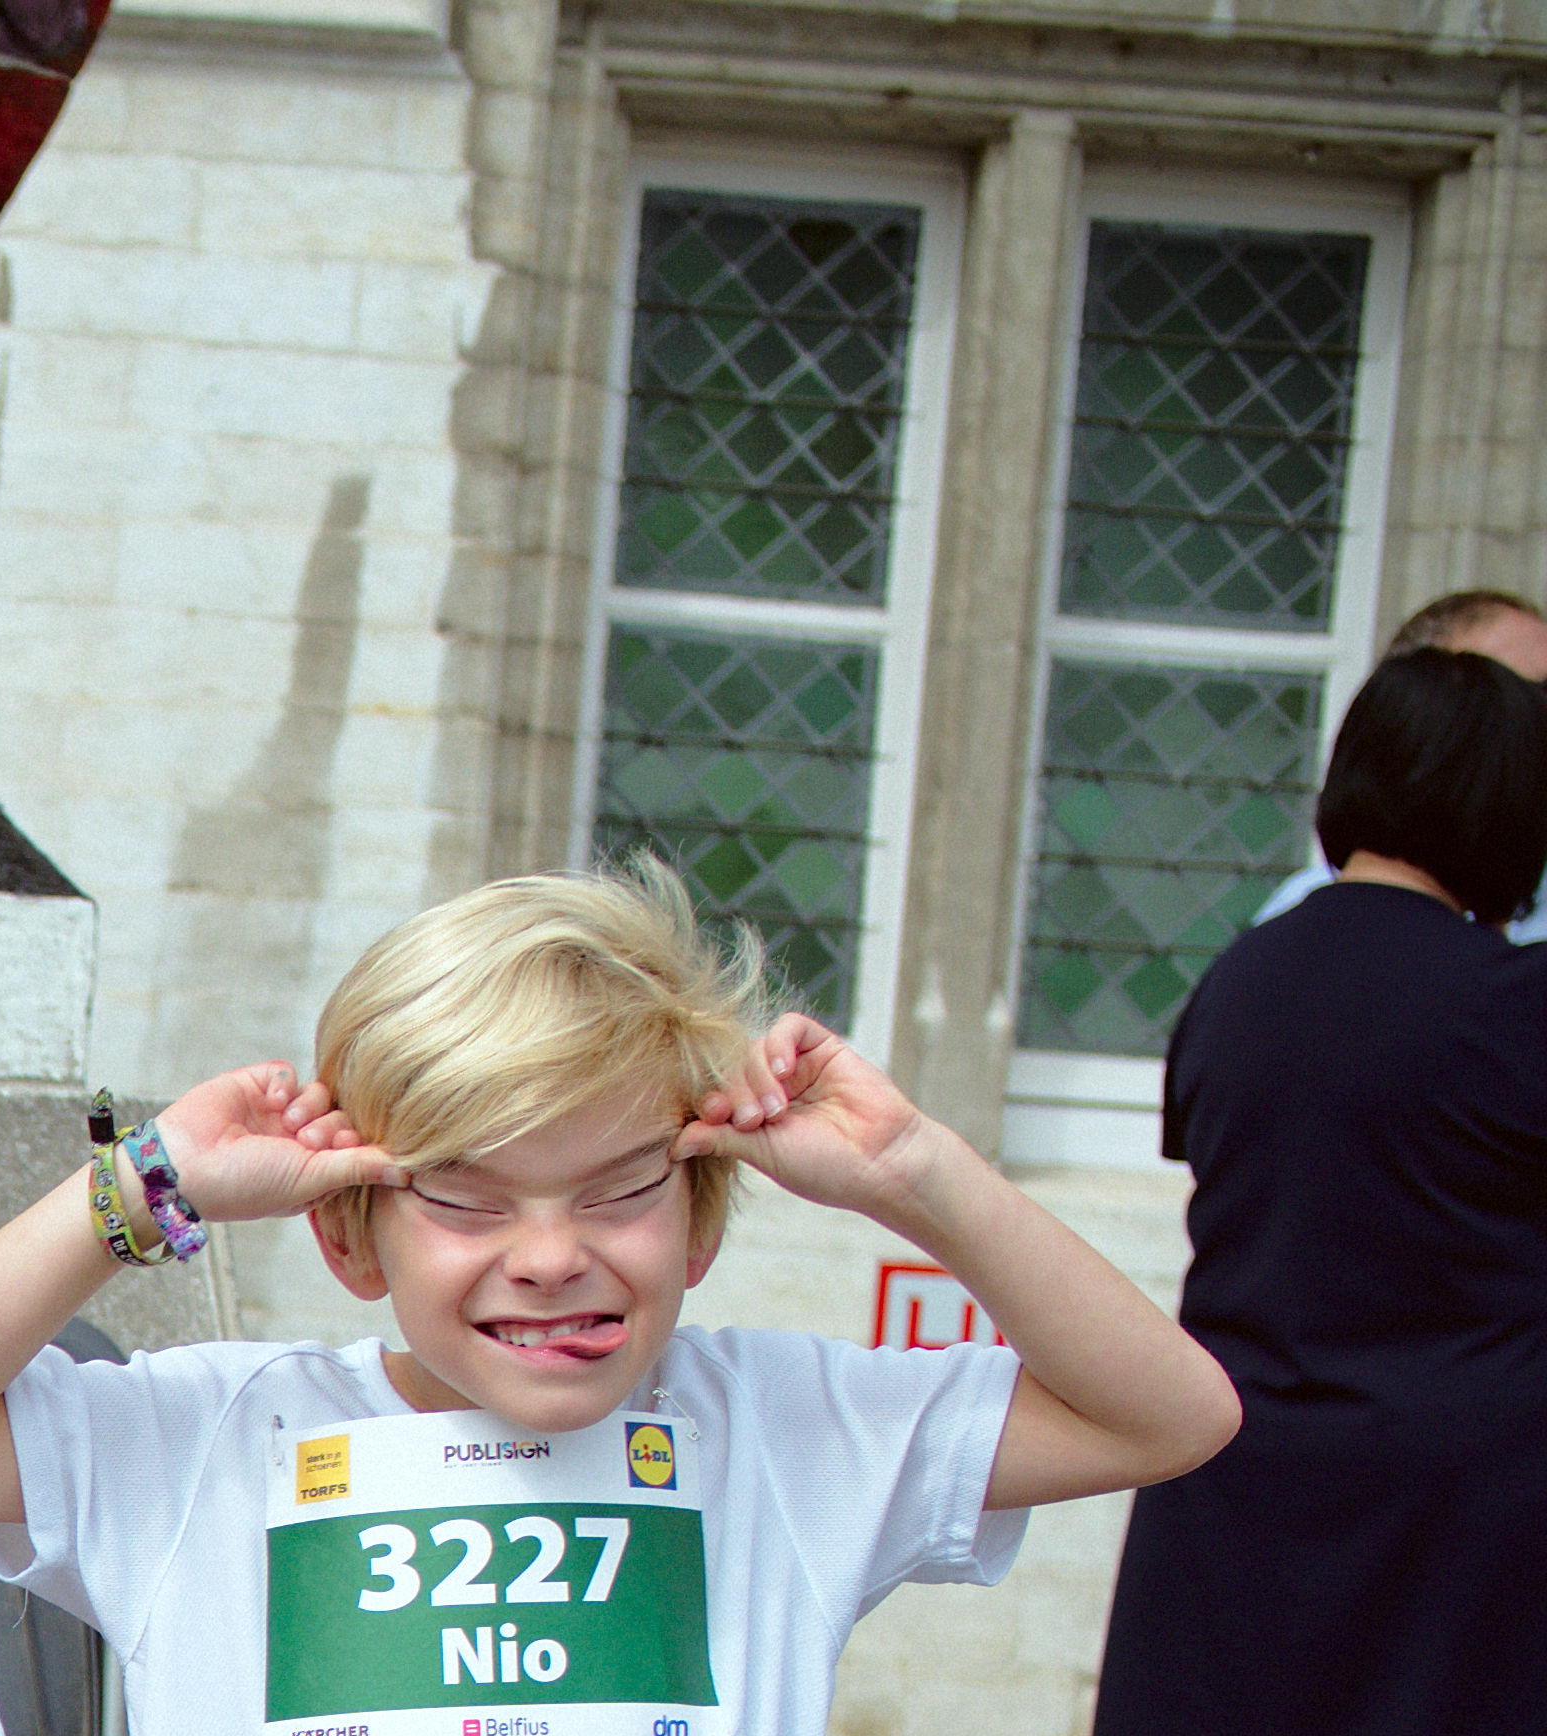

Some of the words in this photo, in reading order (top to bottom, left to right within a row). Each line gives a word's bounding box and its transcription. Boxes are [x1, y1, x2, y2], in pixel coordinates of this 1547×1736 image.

[444, 1441, 550, 1463] PUBLISIGN
[300, 1483, 348, 1499] TORFS
[357, 1516, 630, 1612] 3227
[441, 1622, 569, 1685] Nio
[485, 1718, 549, 1736] Belfius
